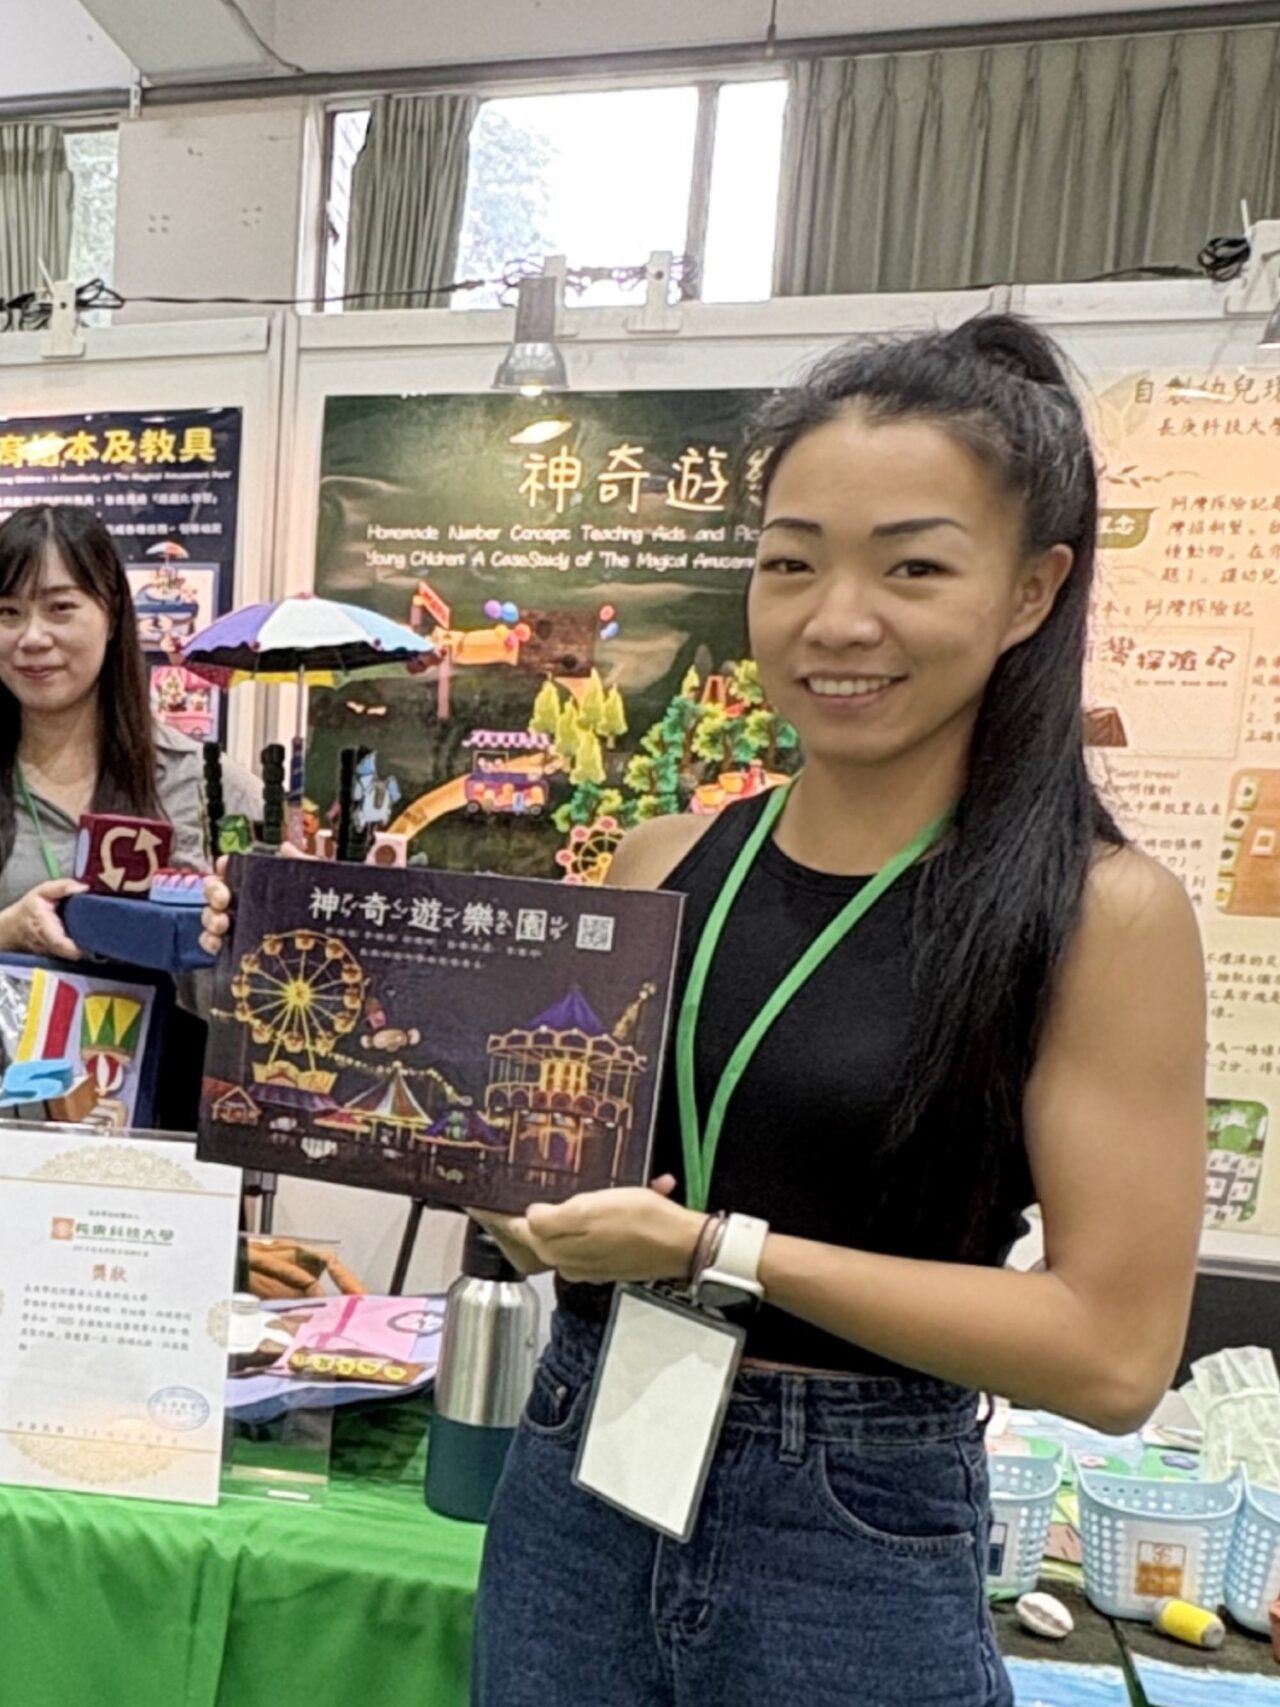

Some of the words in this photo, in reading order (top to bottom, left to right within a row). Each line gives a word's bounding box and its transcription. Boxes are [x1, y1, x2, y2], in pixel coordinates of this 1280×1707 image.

[309, 887, 549, 943] 神奇遊樂園
